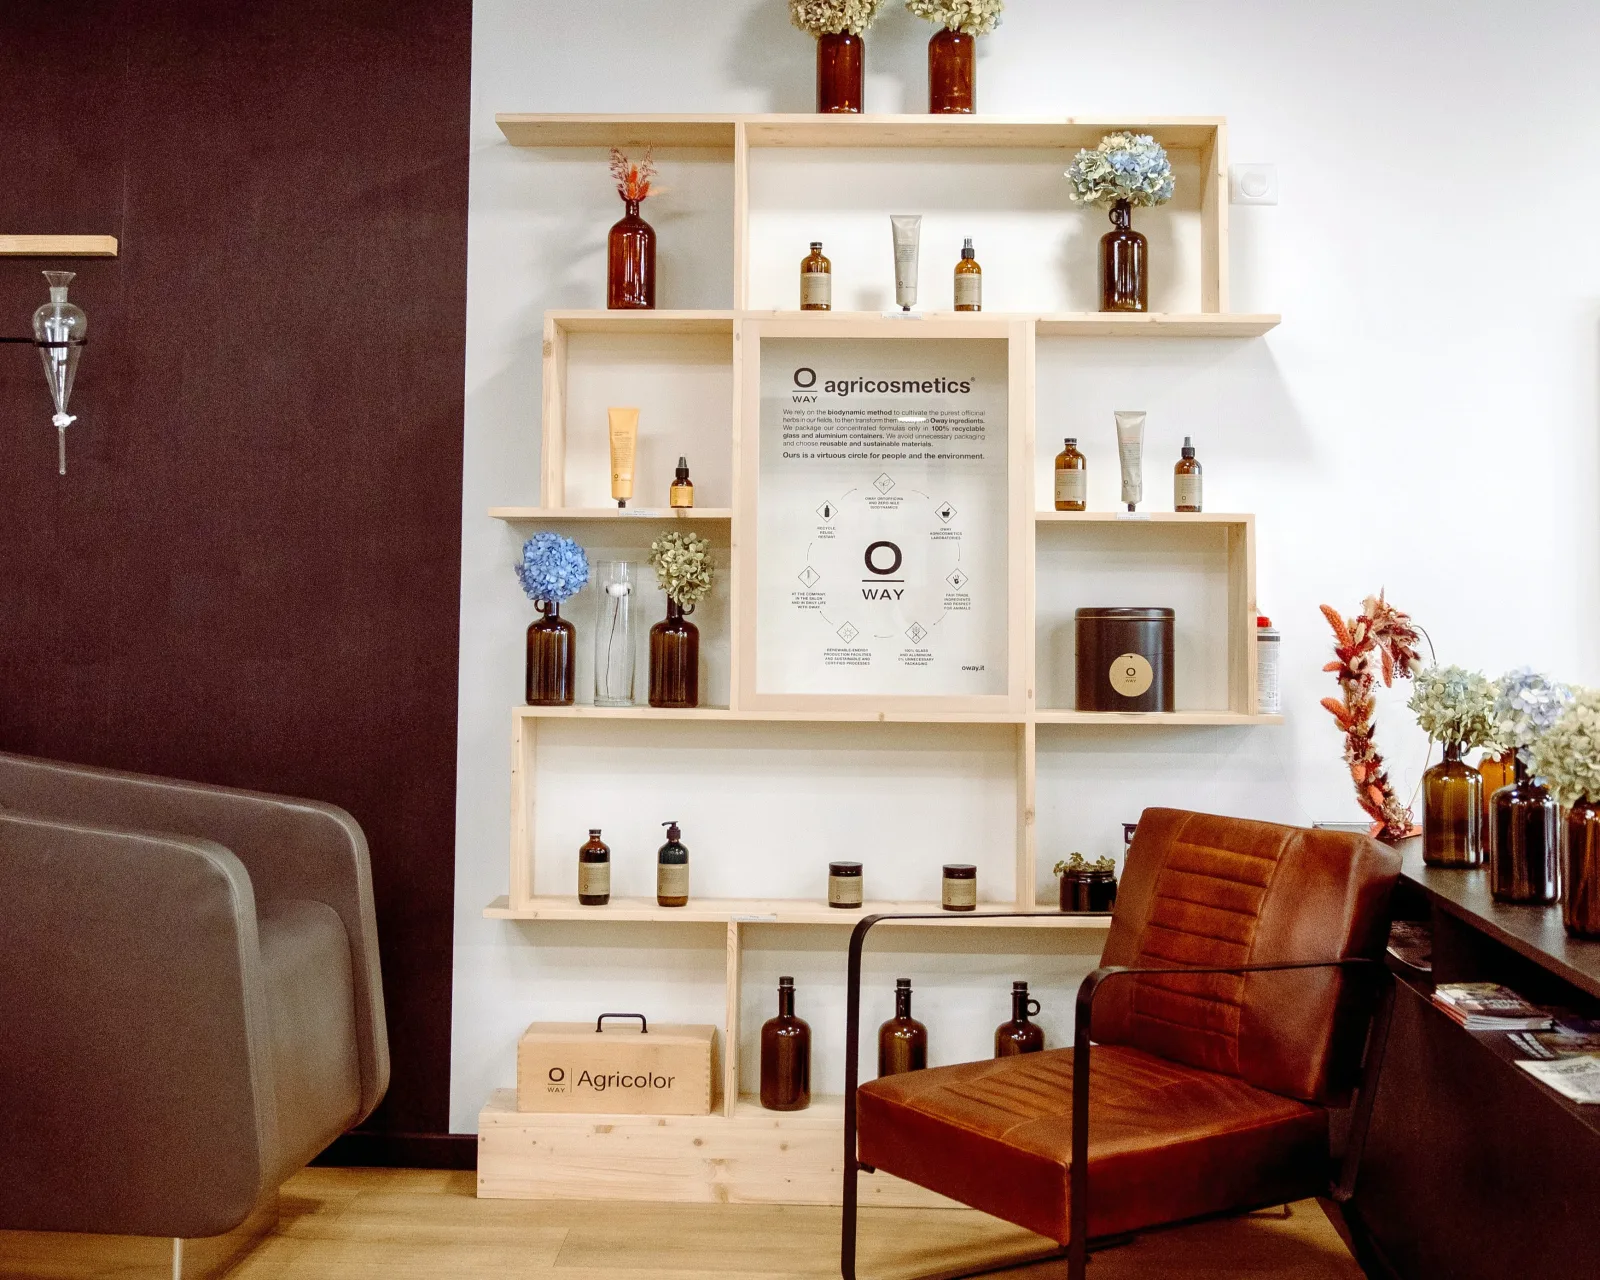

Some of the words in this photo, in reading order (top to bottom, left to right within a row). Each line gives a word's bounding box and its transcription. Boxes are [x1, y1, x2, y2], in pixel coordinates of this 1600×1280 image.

[793, 367, 817, 388] O
[864, 540, 903, 576] O
[861, 588, 905, 601] WAY
[1126, 667, 1136, 677] O
[548, 1067, 564, 1082] O
[577, 1070, 676, 1092] Agricolor
